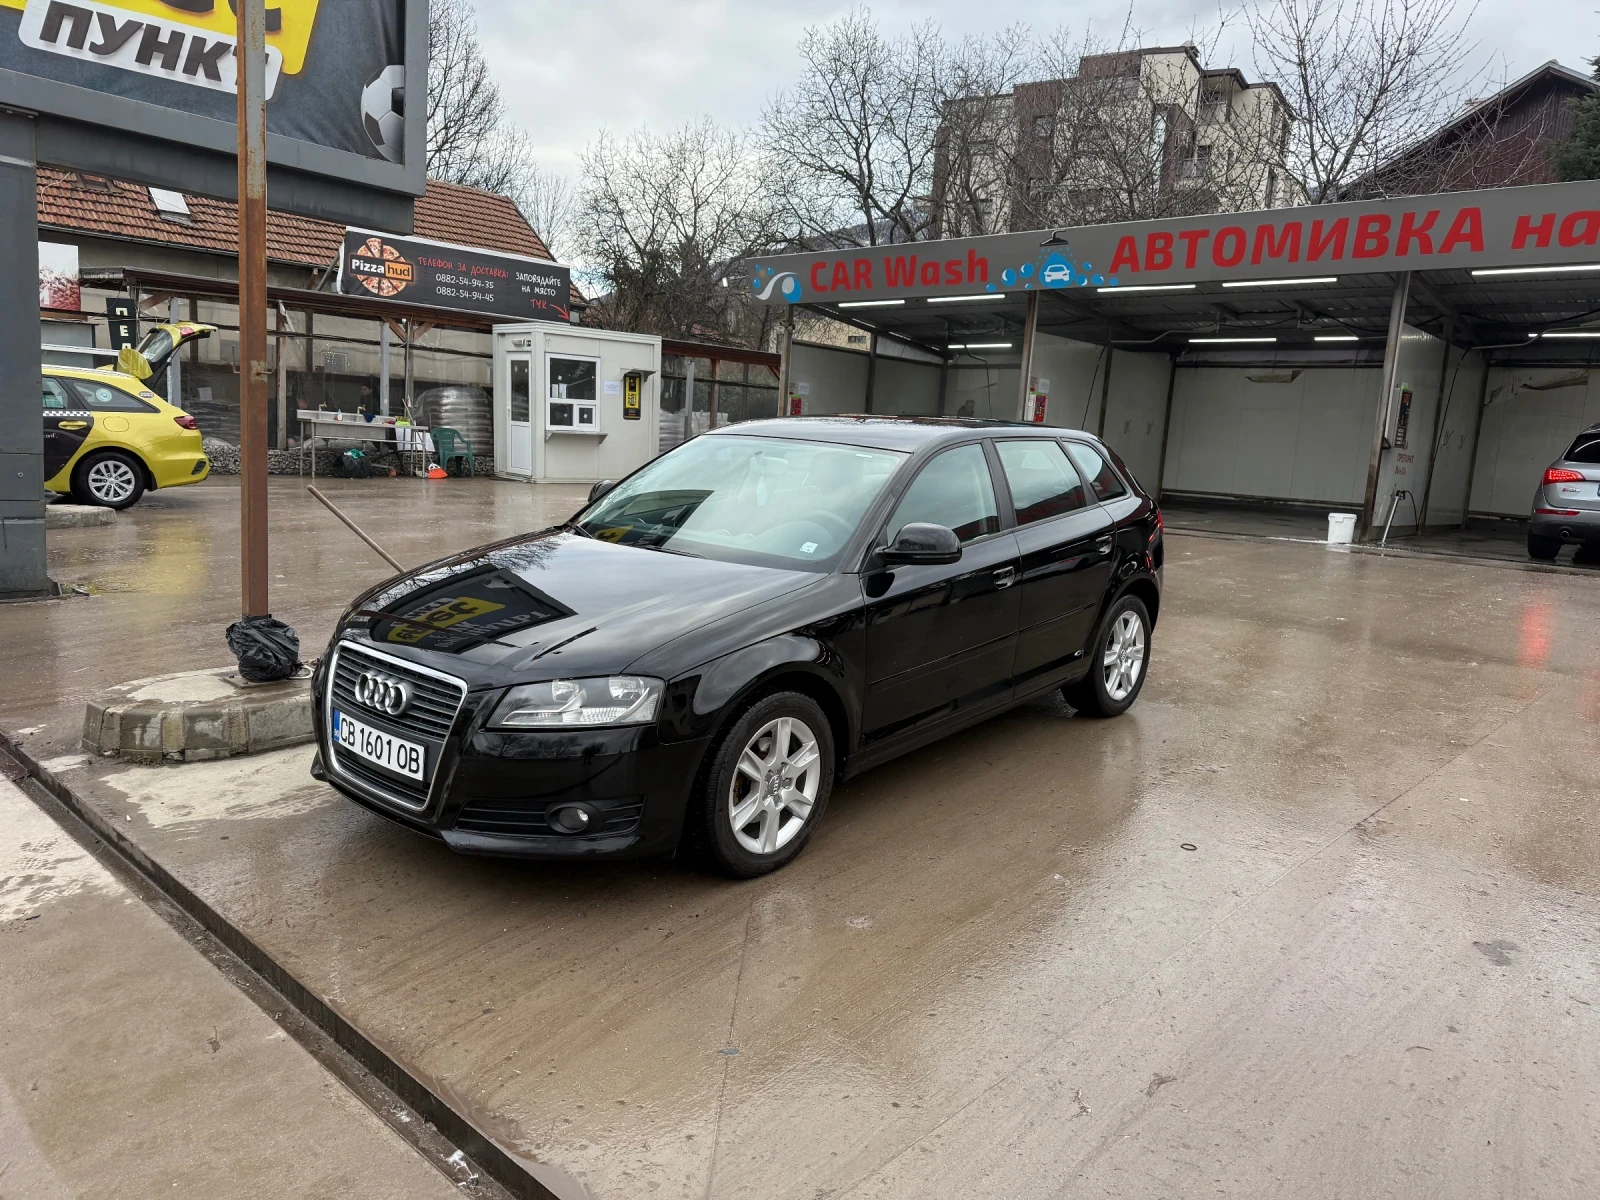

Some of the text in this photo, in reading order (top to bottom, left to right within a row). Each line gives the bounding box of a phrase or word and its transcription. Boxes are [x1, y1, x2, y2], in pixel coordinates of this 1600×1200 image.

[1109, 206, 1485, 274] АВТОМИВКА
[351, 258, 410, 277] Pizza hud
[417, 256, 509, 278] ТЕЛЕФОН ЗА ДОСТАВКА:
[810, 249, 989, 292] CAR Wash
[435, 274, 494, 289] 0882-54-94-35
[515, 272, 562, 287] ЗАПОВЯДАЙТЕ
[436, 287, 494, 302] 0882-54-94-45
[534, 286, 556, 297] МЯСТО
[530, 299, 547, 309] ТУК
[359, 727, 392, 765] 1601
